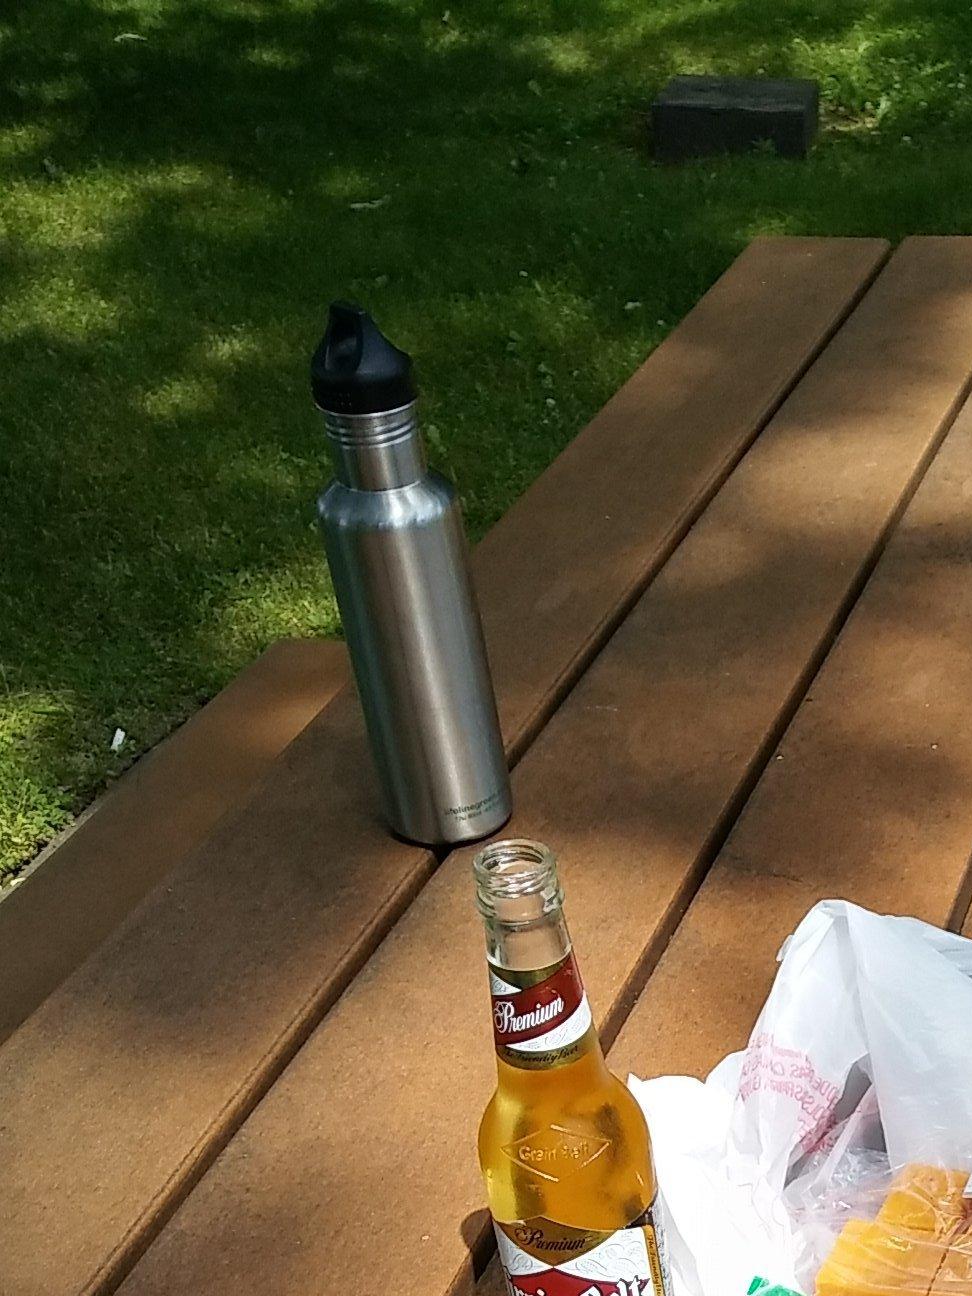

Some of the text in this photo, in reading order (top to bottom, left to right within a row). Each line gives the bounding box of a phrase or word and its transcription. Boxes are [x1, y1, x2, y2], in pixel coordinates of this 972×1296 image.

[494, 997, 564, 1034] Premium
[519, 1145, 557, 1161] Grain
[515, 1226, 586, 1251] Premium
